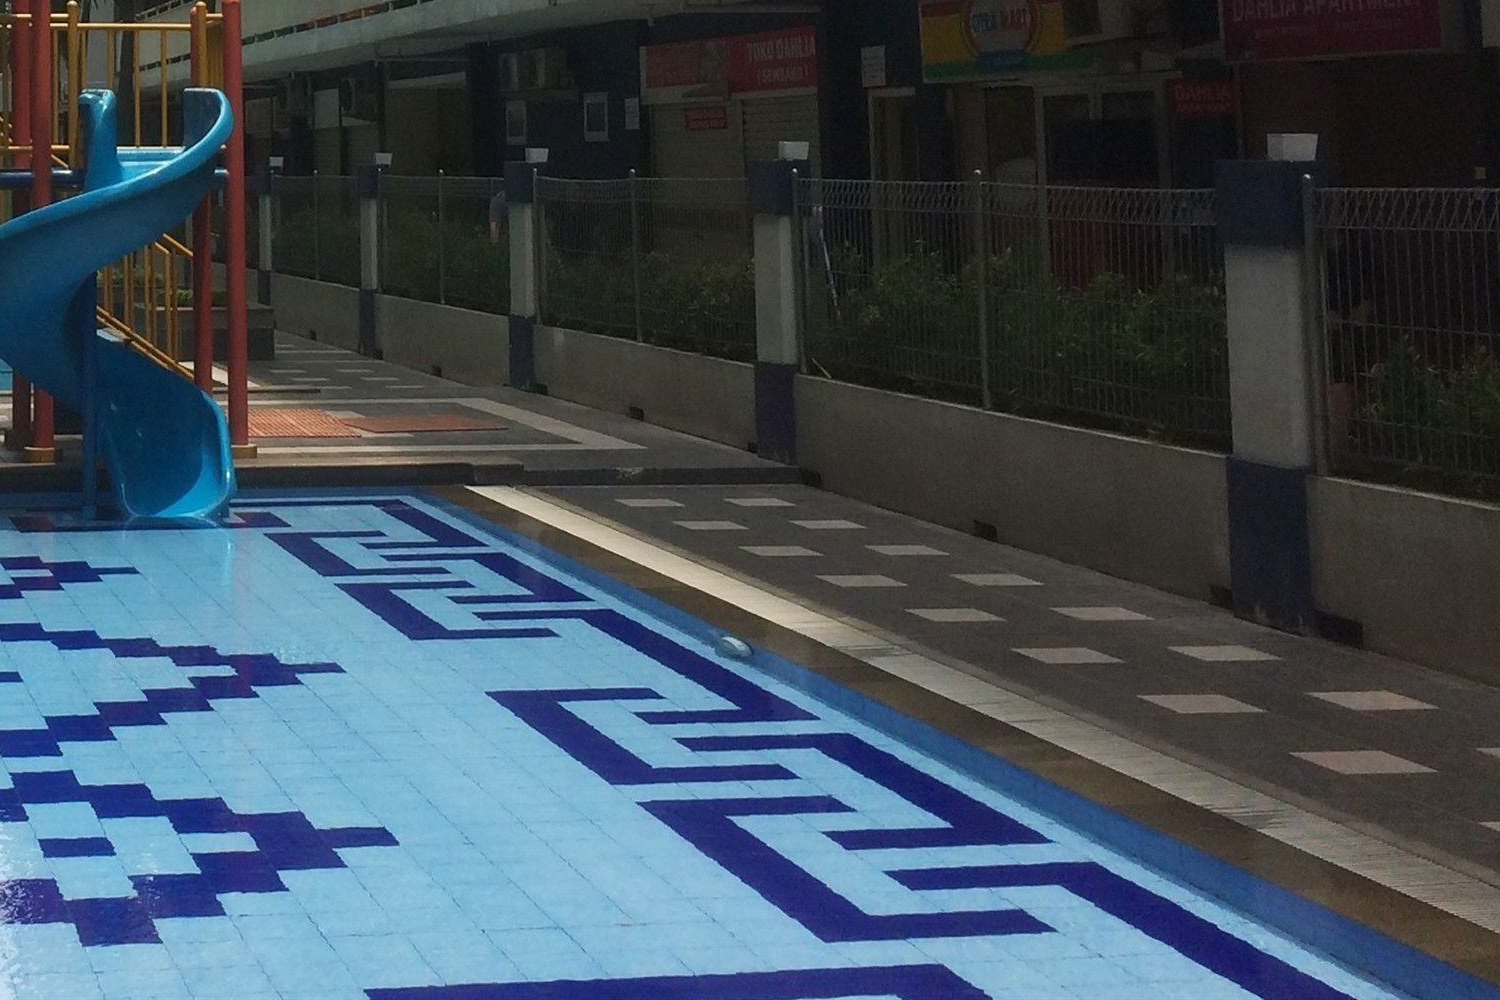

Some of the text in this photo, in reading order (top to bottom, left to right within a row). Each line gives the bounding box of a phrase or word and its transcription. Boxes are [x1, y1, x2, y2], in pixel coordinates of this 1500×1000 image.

[747, 35, 816, 63] TOKO DAHLIA
[1174, 83, 1229, 103] DAHLIA
